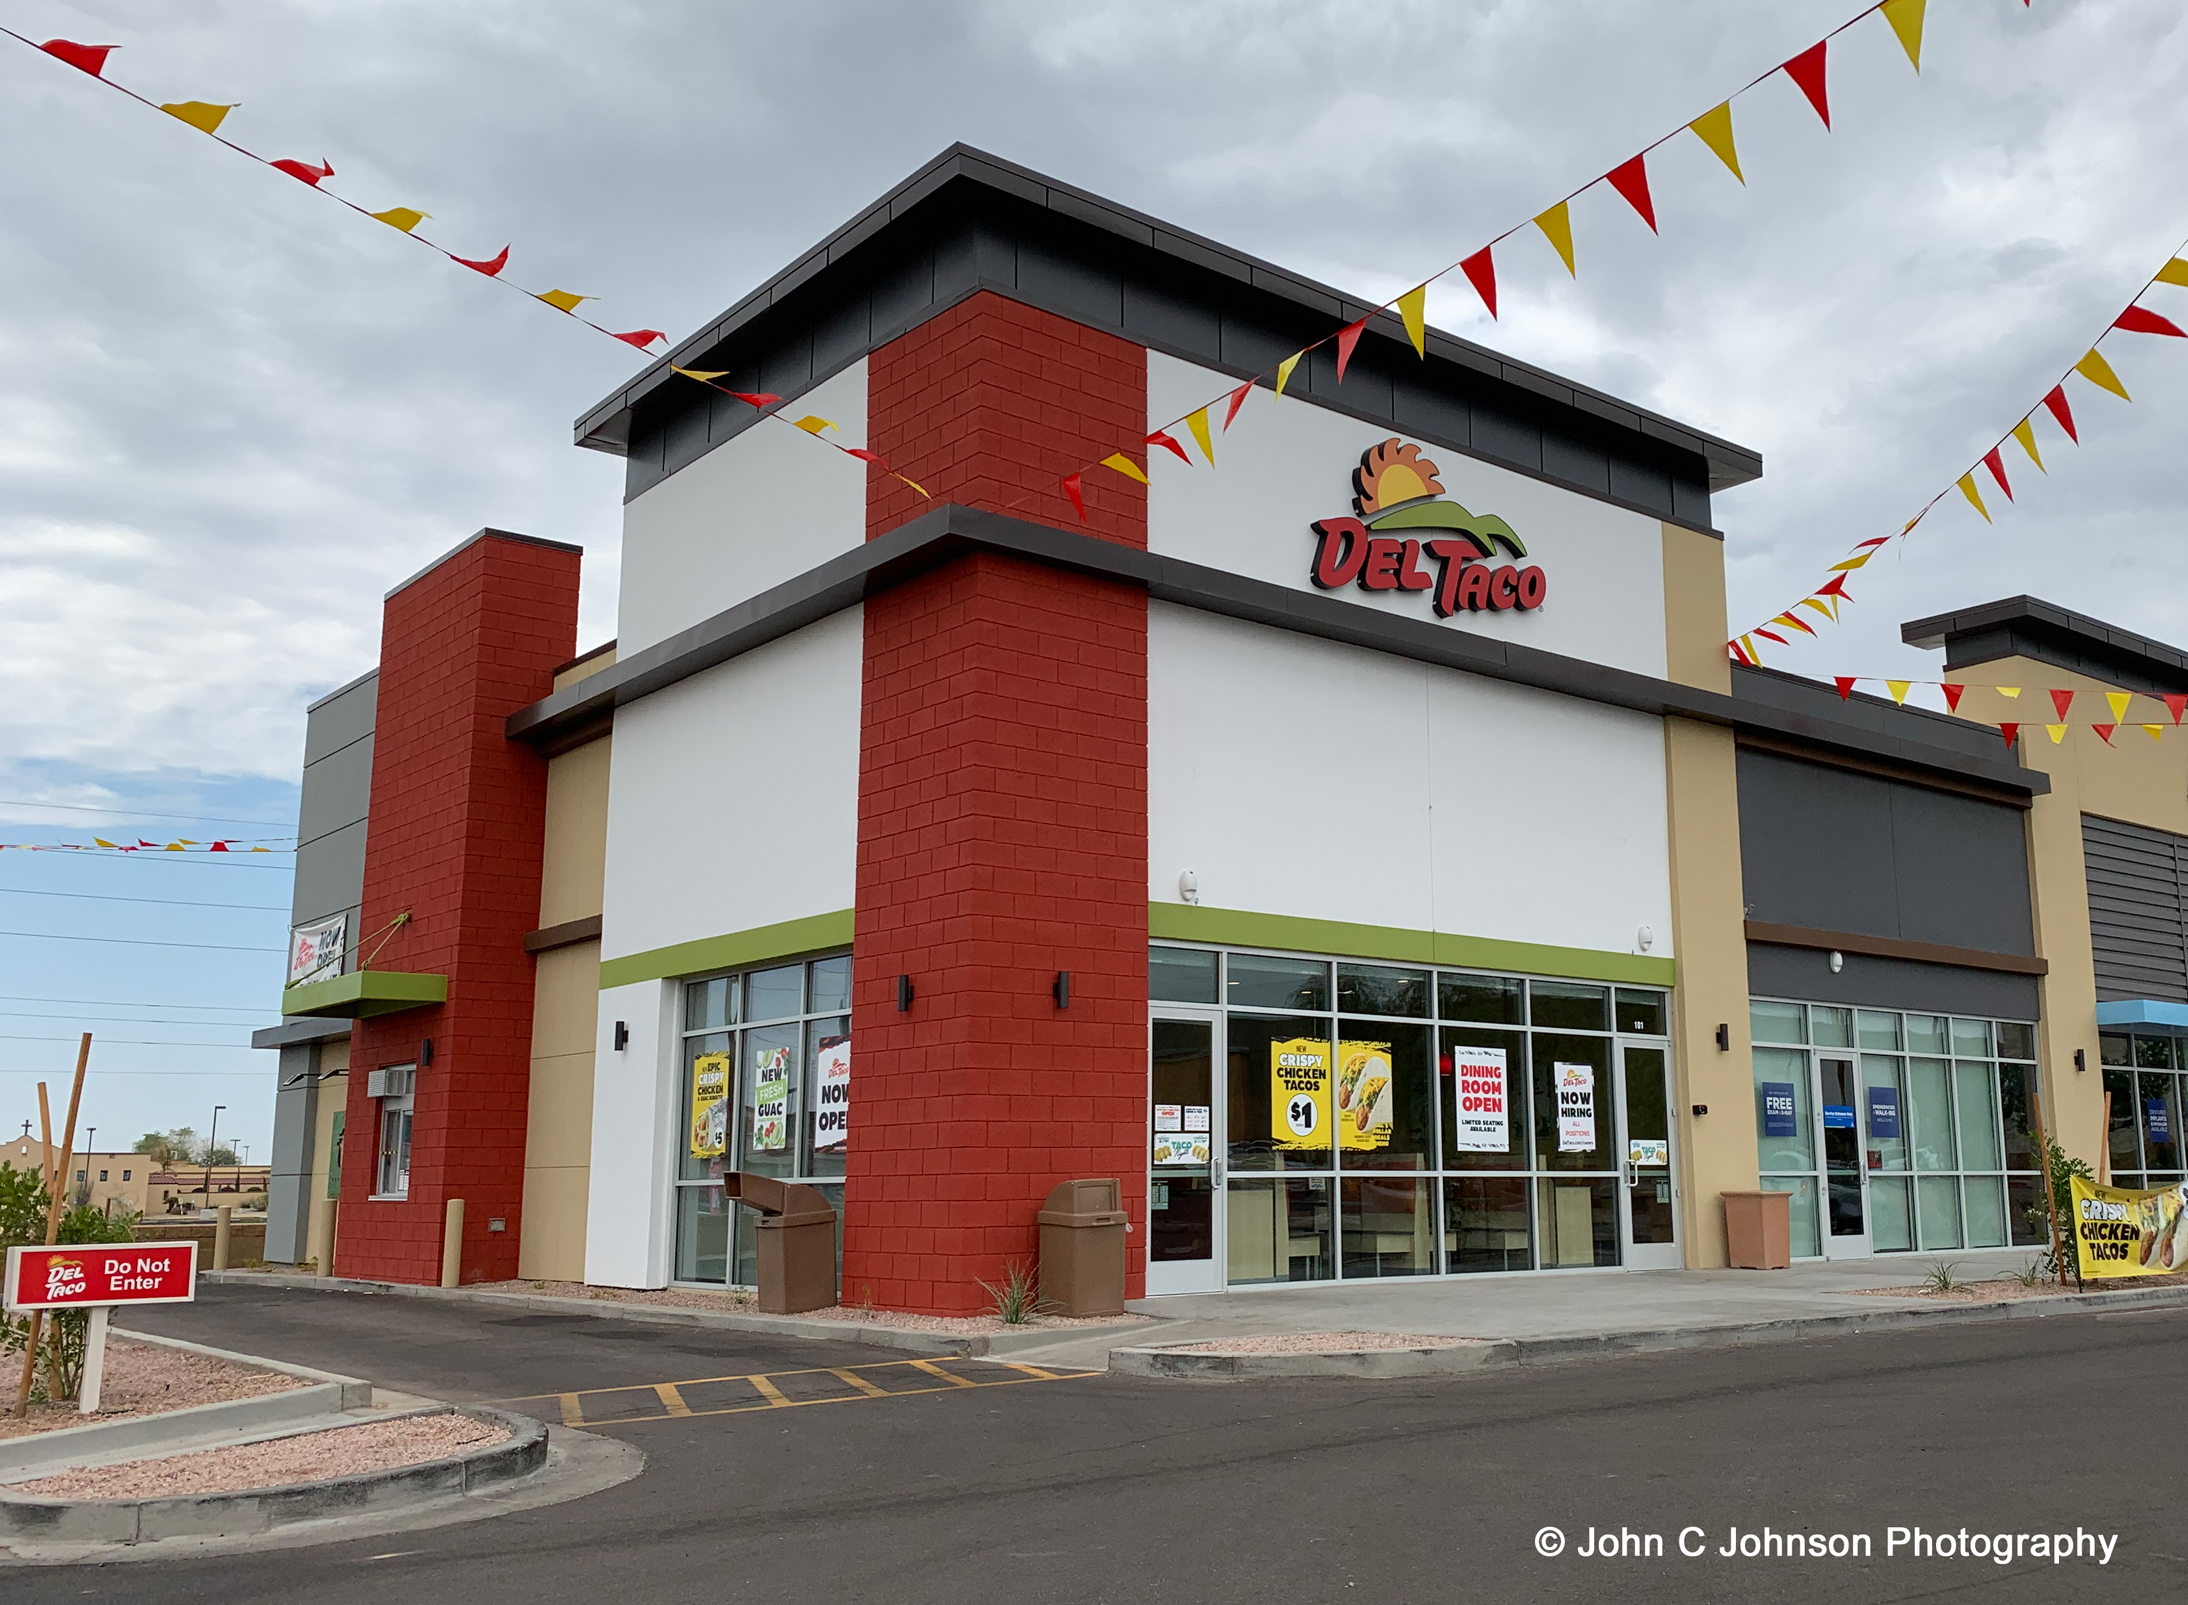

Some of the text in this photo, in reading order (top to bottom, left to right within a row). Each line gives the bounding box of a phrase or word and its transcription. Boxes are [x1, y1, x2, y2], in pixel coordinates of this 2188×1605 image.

[1310, 516, 1547, 620] DEL TACO
[1296, 1045, 1307, 1053] NEW
[707, 1062, 721, 1072] EPIC
[1278, 1053, 1324, 1068] CRISPY
[697, 1071, 725, 1086] CRISPY
[761, 1067, 783, 1083] NEW
[1276, 1067, 1327, 1080] CHICKEN
[1460, 1064, 1502, 1079] DINING
[697, 1084, 724, 1097] CHICKEN
[759, 1082, 784, 1102] FRESH
[1283, 1080, 1321, 1092] TACOS
[1461, 1079, 1502, 1095] ROOM
[1462, 1096, 1503, 1113] OPEN
[1560, 1091, 1591, 1105] NOW
[1766, 1096, 1793, 1110] FREE
[757, 1102, 784, 1117] GUAC
[1290, 1101, 1312, 1129] $1
[1561, 1107, 1592, 1118] HIRING
[819, 1111, 847, 1132] OPE
[715, 1131, 723, 1145] $5
[1171, 1141, 1192, 1149] TACO
[2080, 1222, 2140, 1241] CHICKEN
[2088, 1242, 2130, 1261] TACOS
[104, 1258, 171, 1275] Do Not
[47, 1266, 85, 1283] DEL
[109, 1275, 163, 1291] Enter
[44, 1281, 87, 1301] TACO
